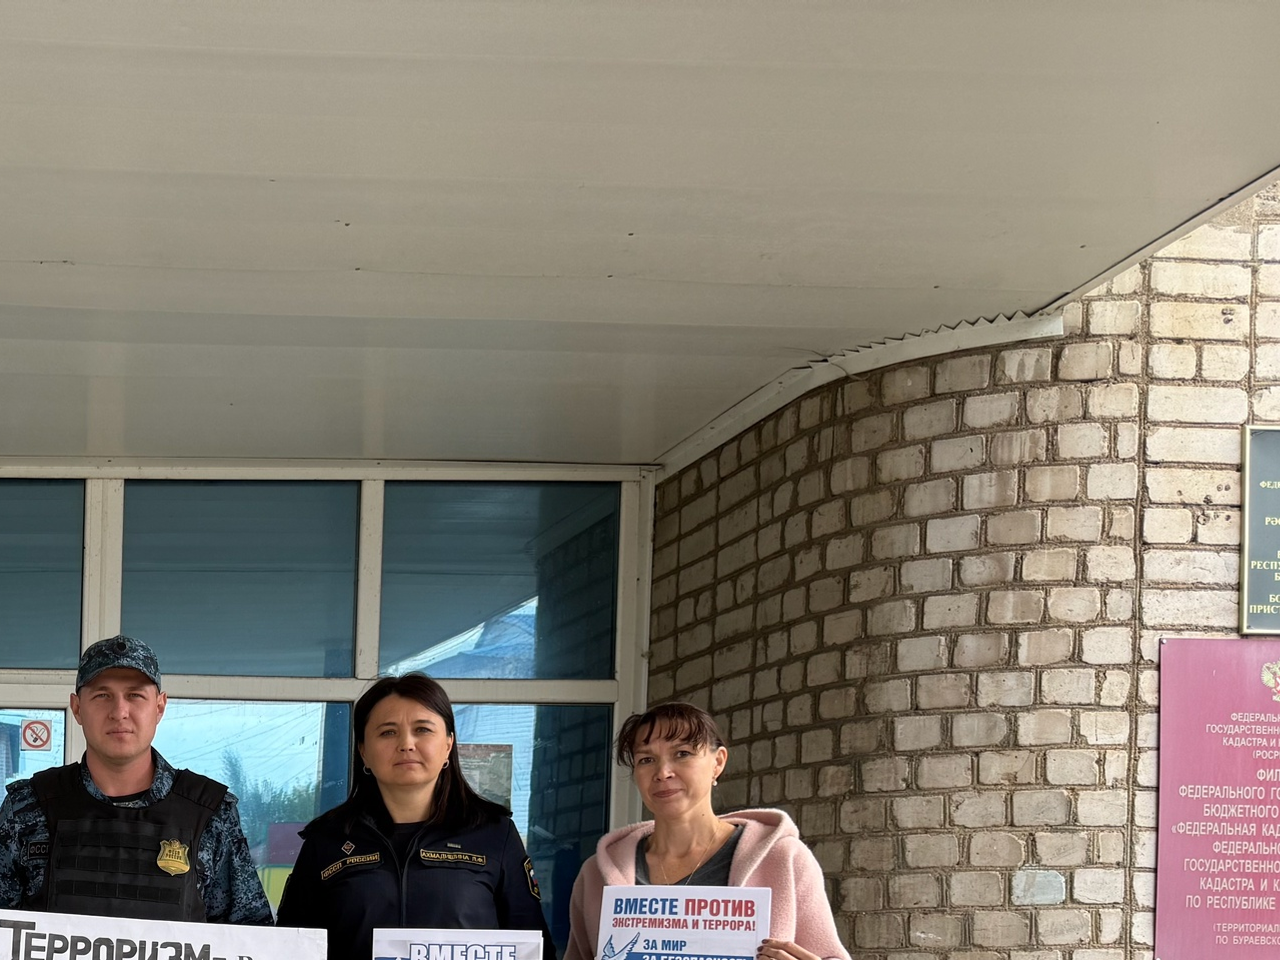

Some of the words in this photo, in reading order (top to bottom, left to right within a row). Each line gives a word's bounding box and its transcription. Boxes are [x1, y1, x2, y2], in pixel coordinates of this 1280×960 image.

[1206, 724, 1280, 734] ГОСУДАРСТВЕНН
[1223, 737, 1268, 747] КАДАСТРА
[1270, 739, 1276, 747] И
[1253, 751, 1280, 759] (РОСР
[1179, 785, 1265, 799] ФЕДЕРАЛЬНОГО
[1204, 804, 1279, 819] БЮДЖЕТНОГО
[1171, 822, 1256, 836] «ФЕДЕРАЛЬНАЯ
[324, 863, 342, 877] ФССП
[347, 855, 378, 864] РОССИИ
[1184, 859, 1280, 874] ГОСУДАРСТВЕННО
[1200, 877, 1254, 892] КАДАСТРА
[1261, 879, 1268, 891] И
[613, 898, 678, 915] ВМЕСТЕ
[684, 899, 755, 917] ПРОТИВ
[1186, 895, 1201, 908] ПО
[1207, 896, 1276, 909] РЕСПУБЛИКЕ
[612, 918, 688, 930] ЭКСТРЕМИЗМА
[692, 919, 699, 930] И
[702, 919, 756, 931] ТЕРРОРА!
[1213, 923, 1280, 932] (ТЕРРИТОРИАЛ
[643, 939, 659, 950] ЗА
[661, 940, 687, 951] МИР
[1216, 936, 1228, 944] ПО
